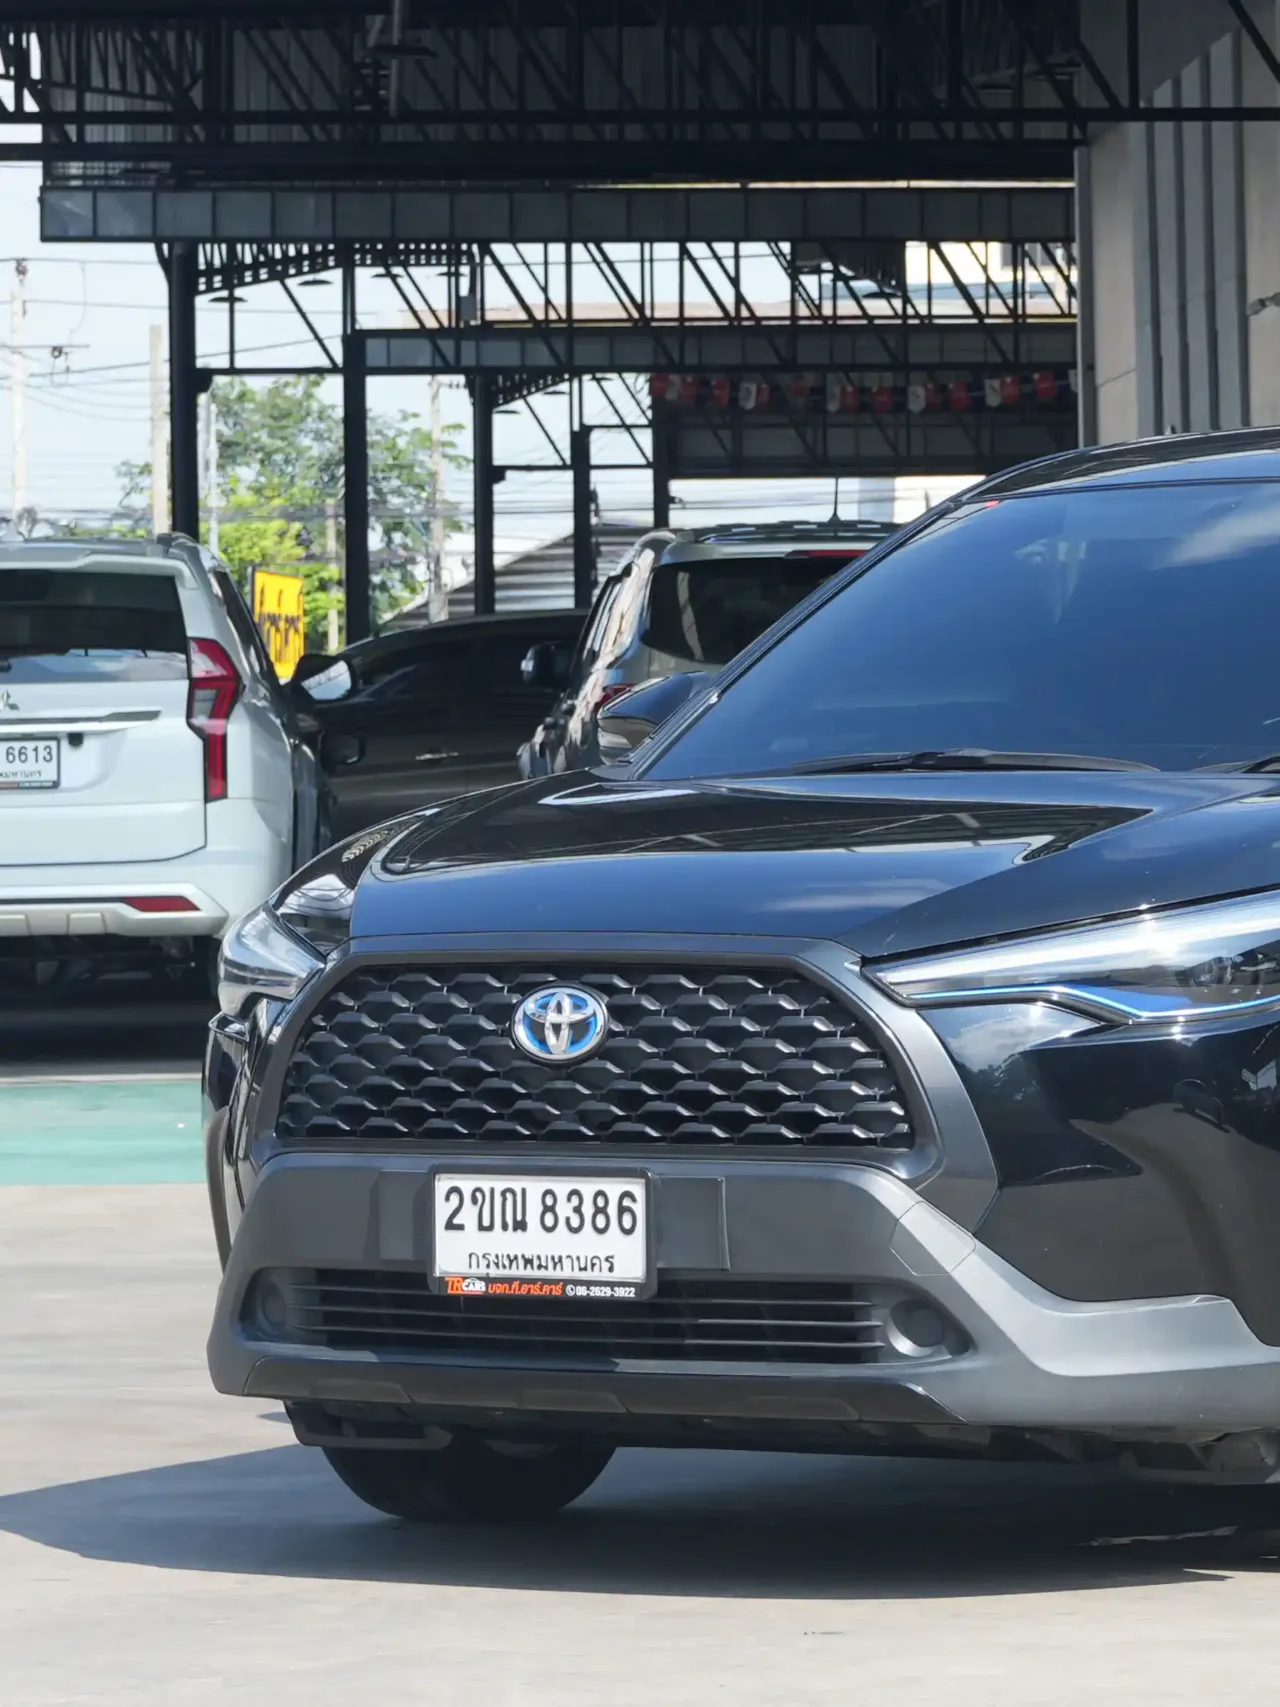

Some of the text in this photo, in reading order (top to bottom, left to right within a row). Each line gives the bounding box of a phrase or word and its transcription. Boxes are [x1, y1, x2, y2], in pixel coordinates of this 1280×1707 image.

[6, 745, 53, 764] 6613
[445, 1186, 638, 1236] 2ขณ 8386
